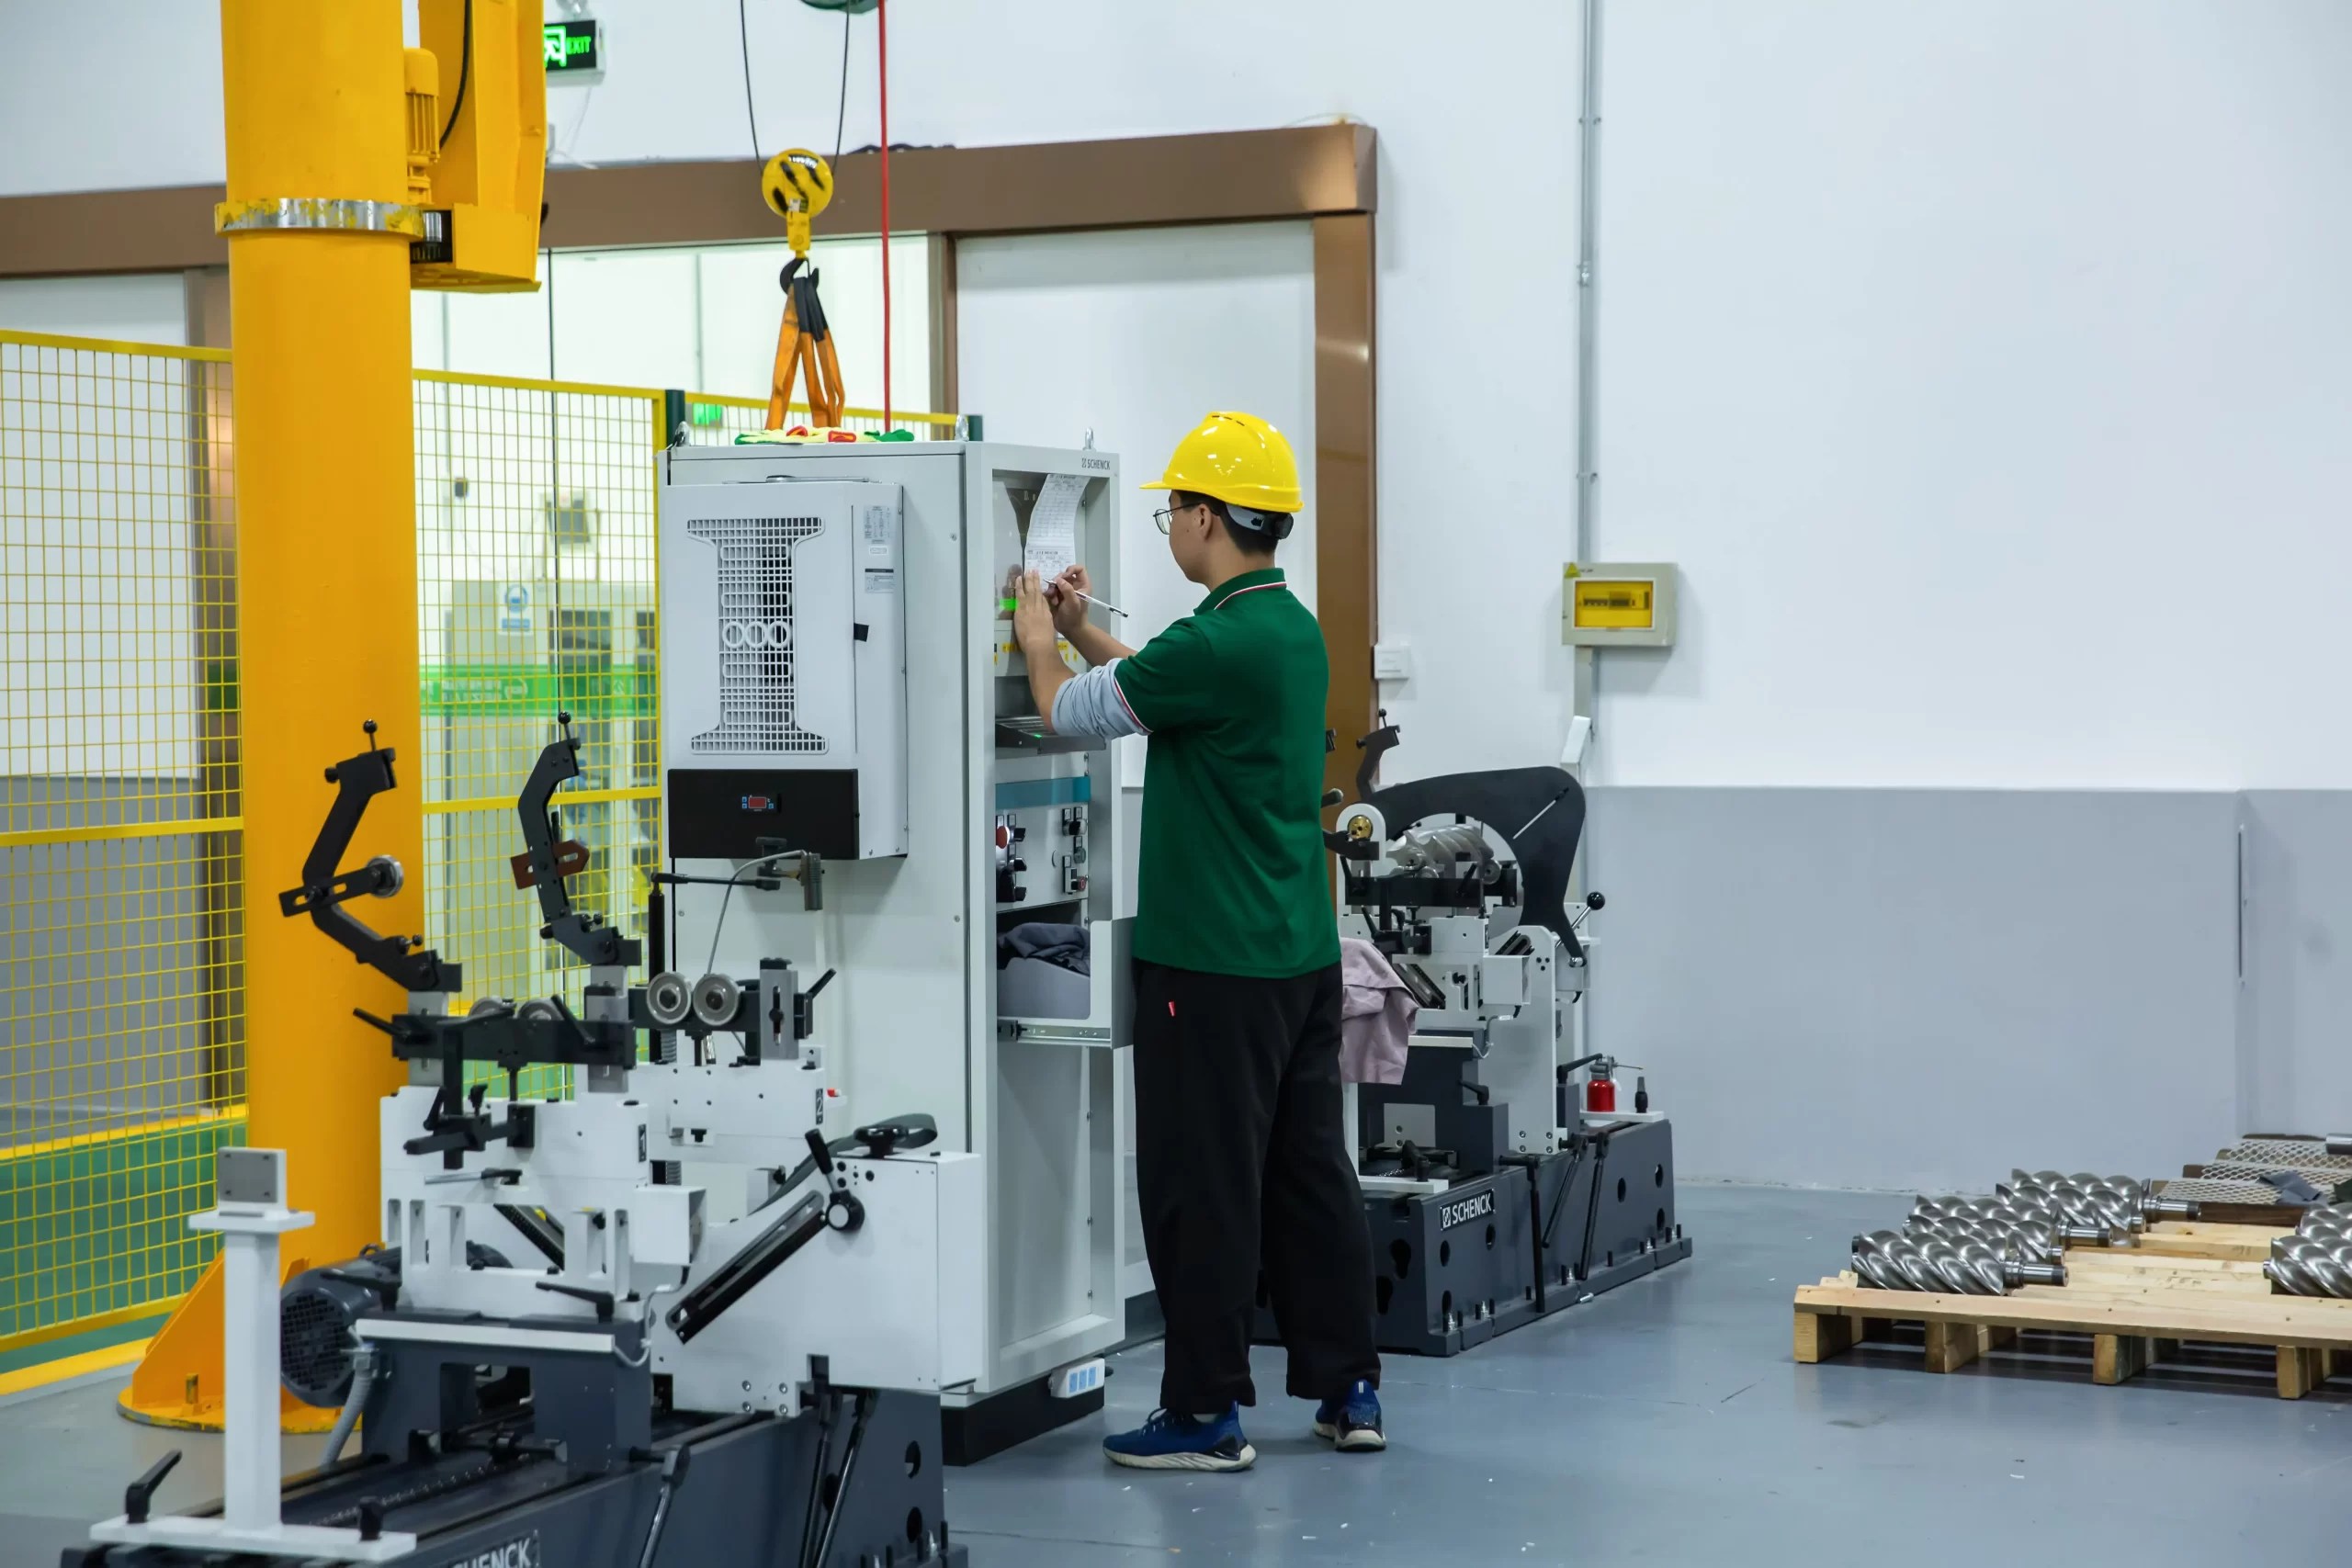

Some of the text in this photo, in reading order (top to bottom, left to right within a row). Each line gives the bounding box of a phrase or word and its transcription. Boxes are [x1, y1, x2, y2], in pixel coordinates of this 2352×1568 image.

[566, 36, 592, 55] EXIT
[1087, 458, 1111, 470] SCHENCK
[817, 1097, 823, 1116] 2
[1452, 1192, 1492, 1225] SCHENCK
